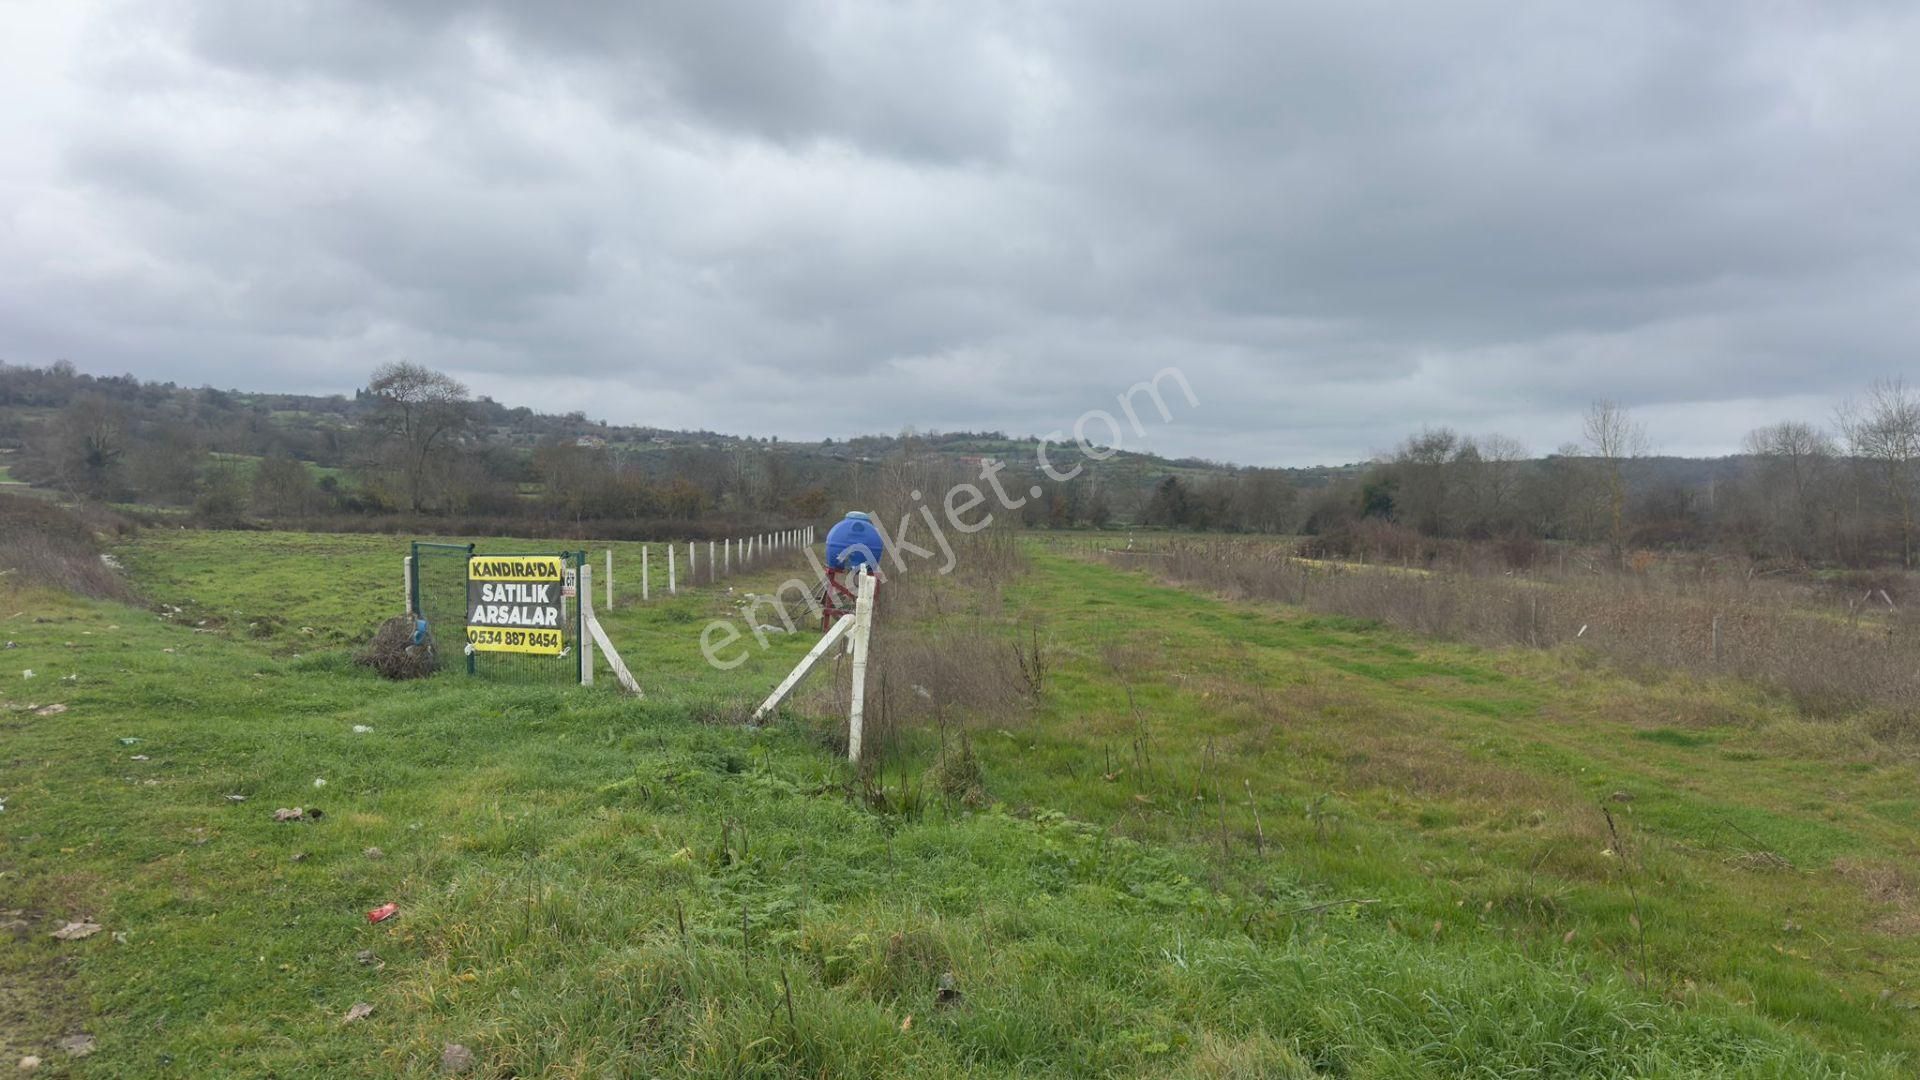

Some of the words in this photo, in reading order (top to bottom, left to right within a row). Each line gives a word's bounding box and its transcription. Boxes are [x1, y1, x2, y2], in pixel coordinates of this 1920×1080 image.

[472, 562, 558, 578] KANDIRA'DA
[481, 583, 549, 603] SATILIK
[471, 605, 558, 626] ARSALAR
[470, 630, 502, 645] 0534
[504, 632, 526, 646] 887
[528, 633, 558, 648] 8454
